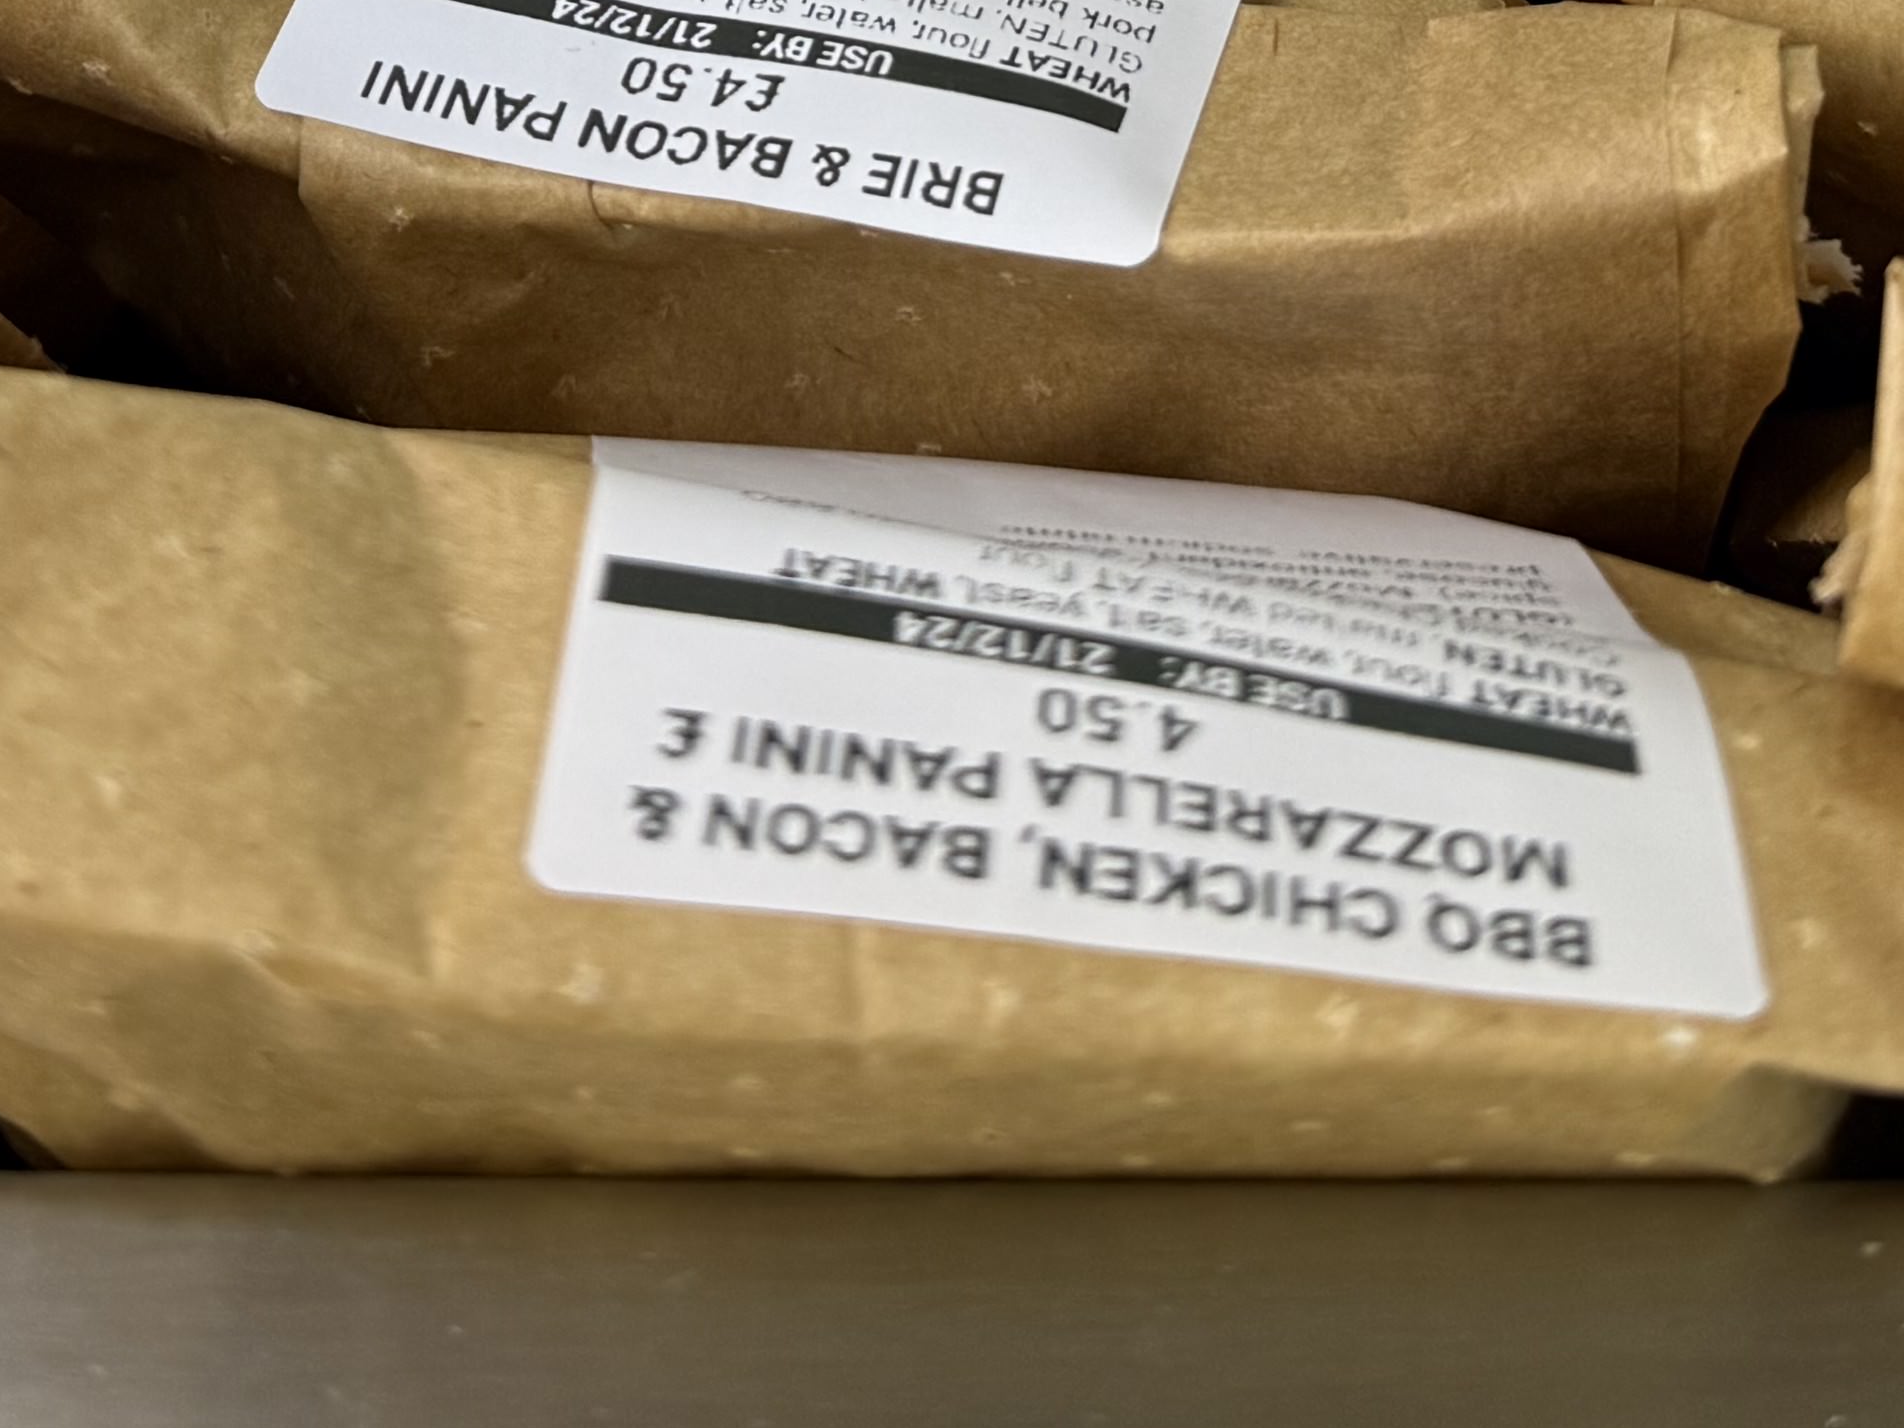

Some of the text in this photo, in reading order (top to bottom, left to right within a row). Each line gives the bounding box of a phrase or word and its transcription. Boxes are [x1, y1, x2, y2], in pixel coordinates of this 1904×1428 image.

[752, 32, 812, 62] BY:
[1082, 7, 1157, 44] pork
[621, 57, 784, 112] £4.50
[818, 42, 894, 77] USE
[1000, 46, 1130, 102] WHEAT
[362, 61, 1003, 215] BRIE & BACON PANINI
[893, 610, 1346, 718] USE BY: 21/12/24
[1036, 687, 1199, 754] 4.50
[658, 708, 1568, 888] MOZZARELLA PANINI £
[629, 785, 1593, 970] BBQ CHICKEN, BACON &
